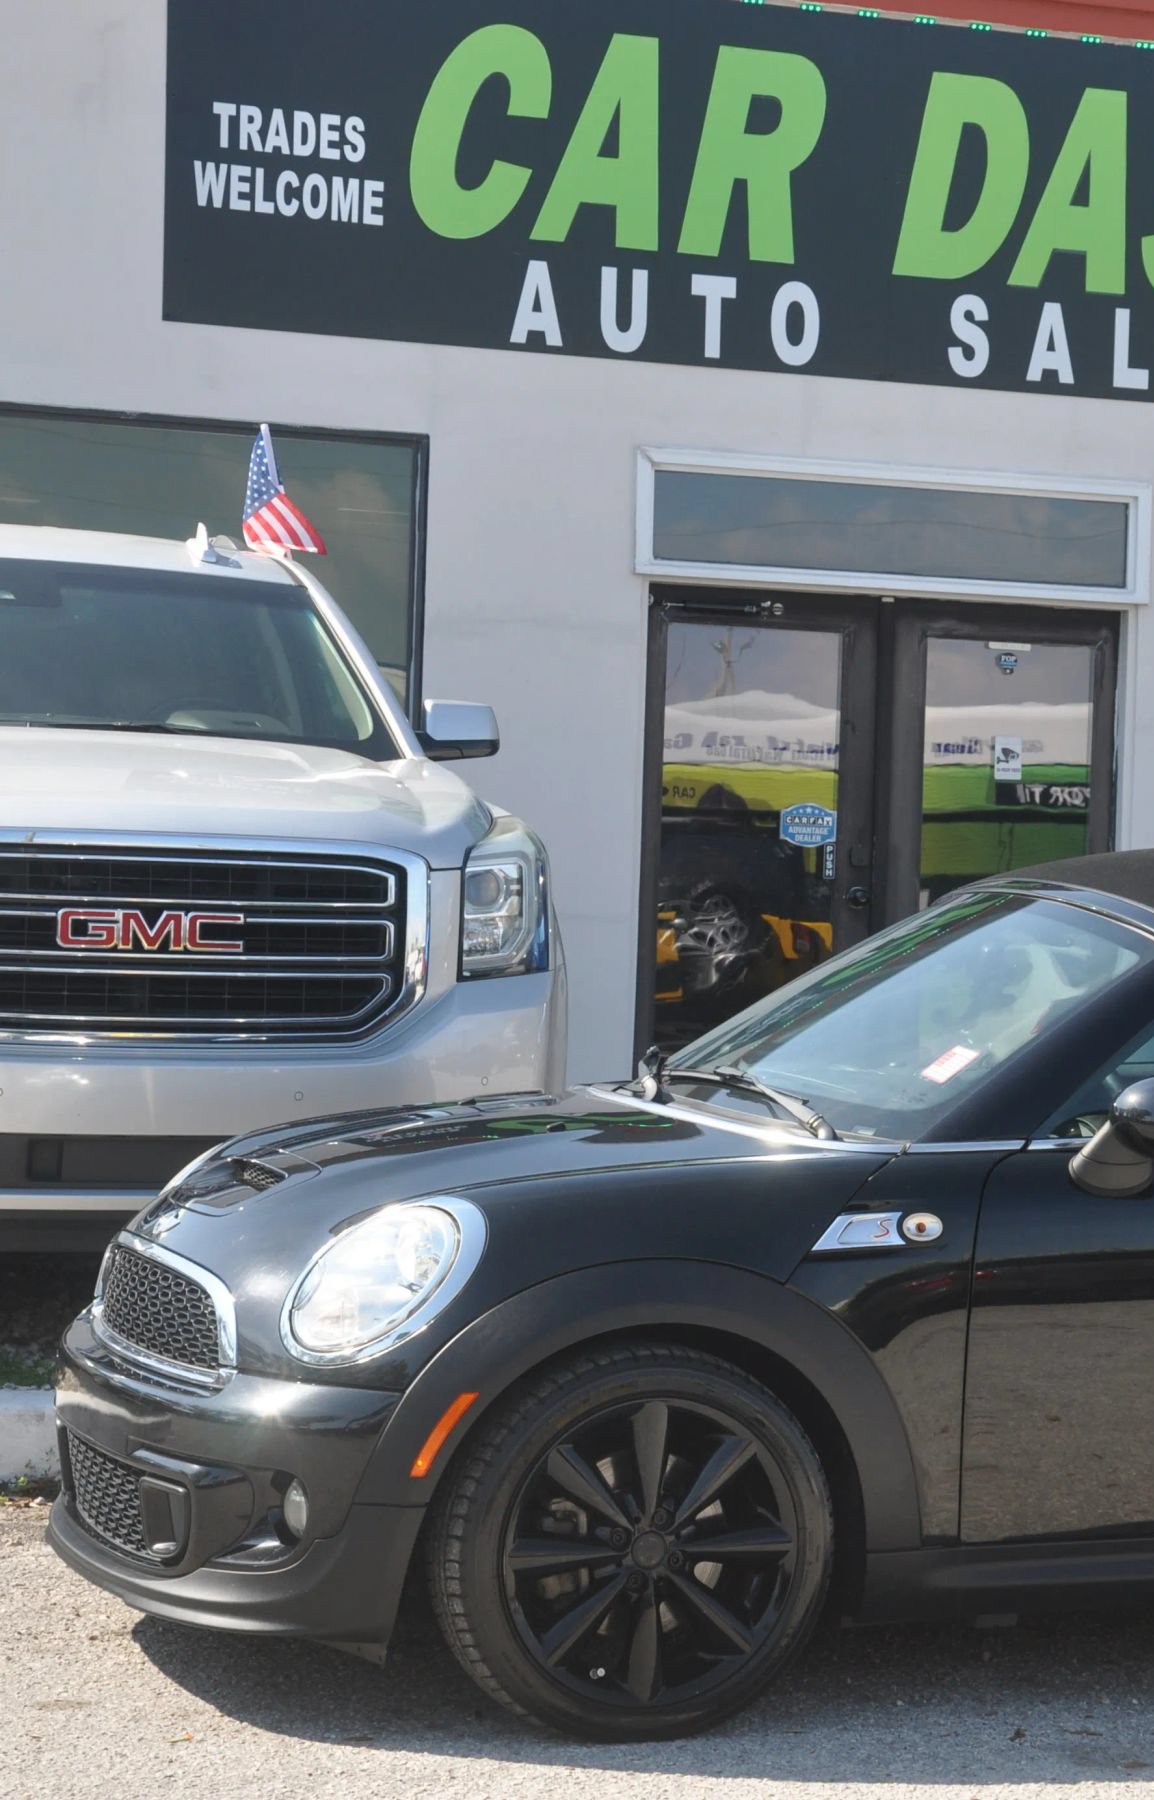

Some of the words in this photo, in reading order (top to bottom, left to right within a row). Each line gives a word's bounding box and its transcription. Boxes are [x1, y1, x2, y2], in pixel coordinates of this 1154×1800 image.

[212, 101, 367, 163] TRADES
[409, 24, 826, 263] CAR
[193, 160, 385, 226] WELCOME
[509, 260, 820, 367] AUTO
[785, 816, 833, 826] CARFAX
[788, 826, 829, 835] ADVANTAGE
[795, 834, 822, 842] DEALER
[825, 845, 834, 877] PUSH
[56, 908, 244, 953] GMC
[872, 1218, 895, 1239] S
